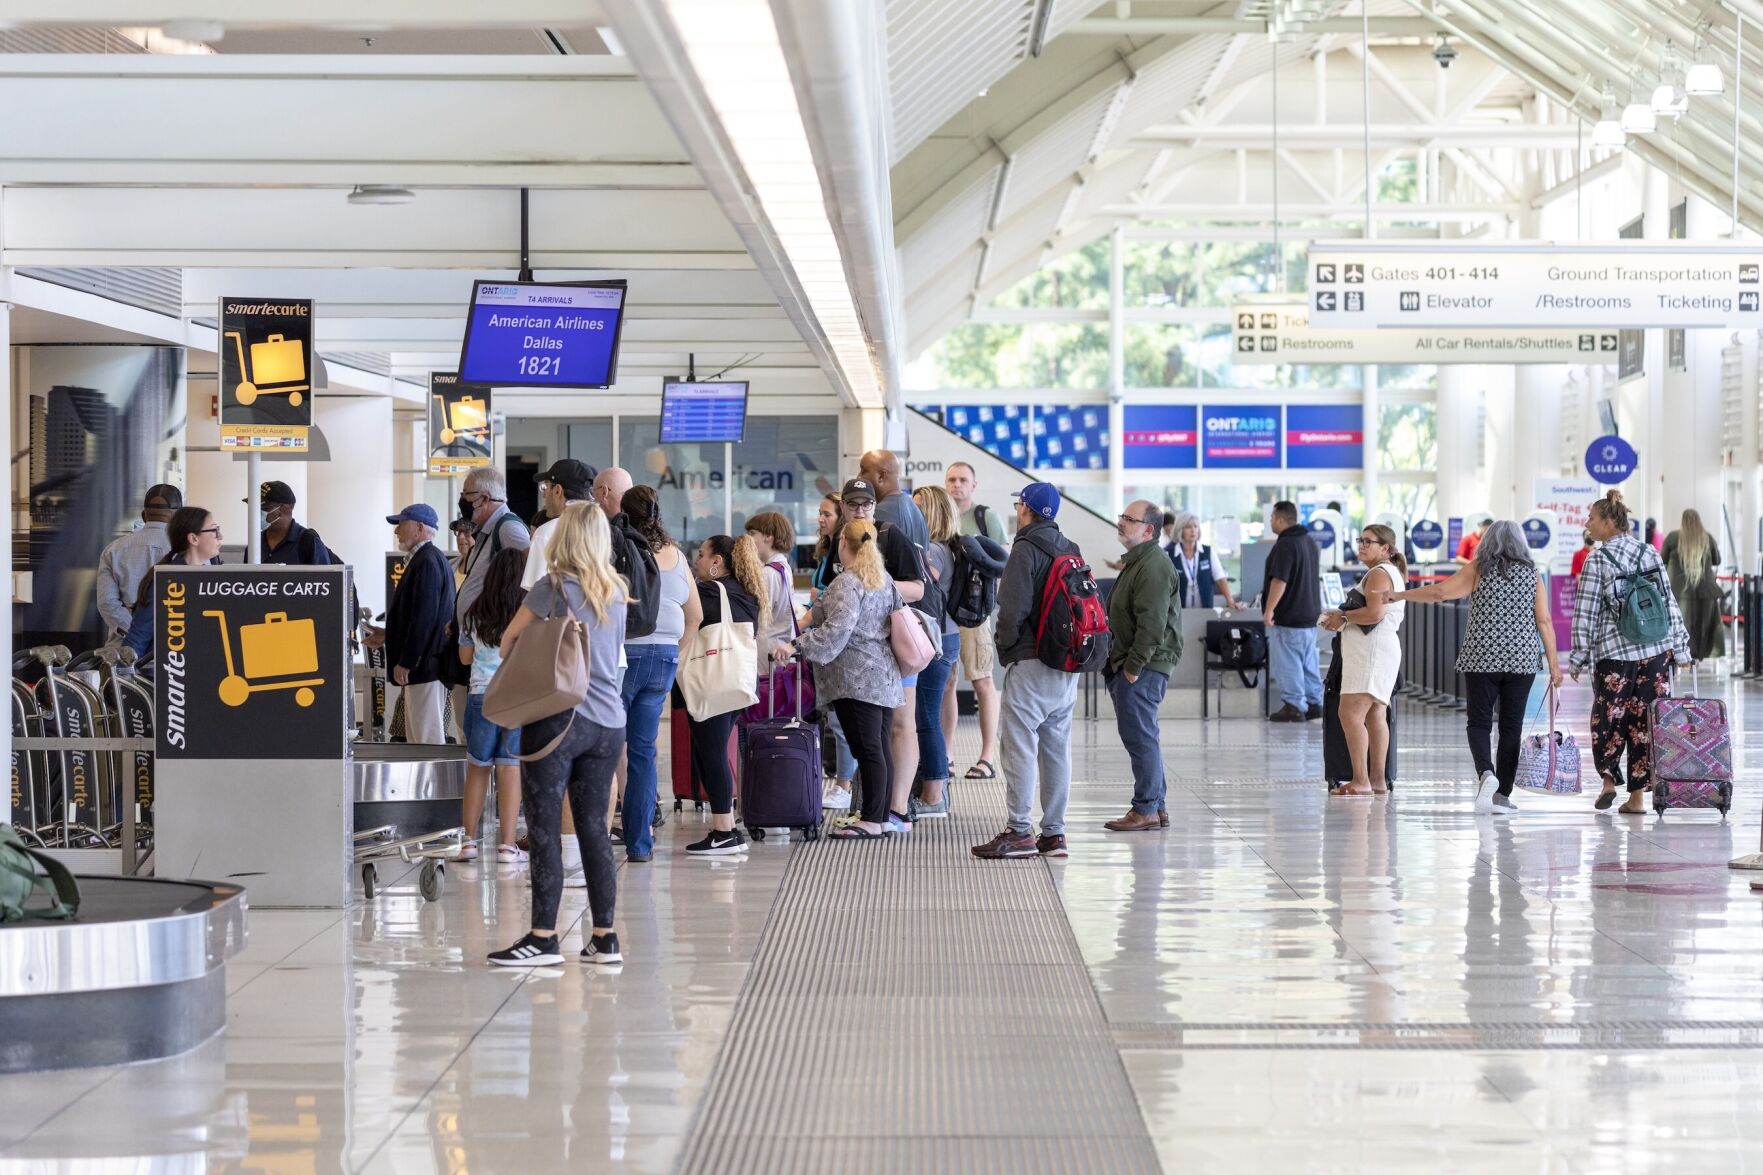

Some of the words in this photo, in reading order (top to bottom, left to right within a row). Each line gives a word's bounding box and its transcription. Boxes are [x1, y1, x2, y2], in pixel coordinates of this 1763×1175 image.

[1371, 266, 1420, 281] Gates
[1547, 266, 1608, 281] Ground
[1615, 266, 1732, 283] Transportation
[537, 296, 573, 304] ARRIVALS
[1427, 295, 1494, 309] Elevator
[1535, 295, 1632, 309] /Restrooms
[1657, 295, 1732, 312] Ticketing
[225, 302, 308, 316] smartecarte
[488, 314, 551, 328] American
[554, 316, 604, 330] Airlines
[1284, 315, 1309, 327] Tick
[523, 336, 563, 350] Dallas
[1282, 338, 1354, 350] Restrooms
[1416, 337, 1432, 350] All
[1436, 337, 1459, 350] Car
[1464, 337, 1573, 350] Rentals/Shuttles
[518, 356, 561, 376] 1821
[1206, 417, 1276, 431] ONTARIO
[1593, 464, 1627, 473] CLEAR
[1552, 486, 1592, 494] Southwest
[198, 582, 278, 596] LUGGAGE
[282, 582, 330, 596] CARTS
[163, 582, 186, 750] smartecarte
